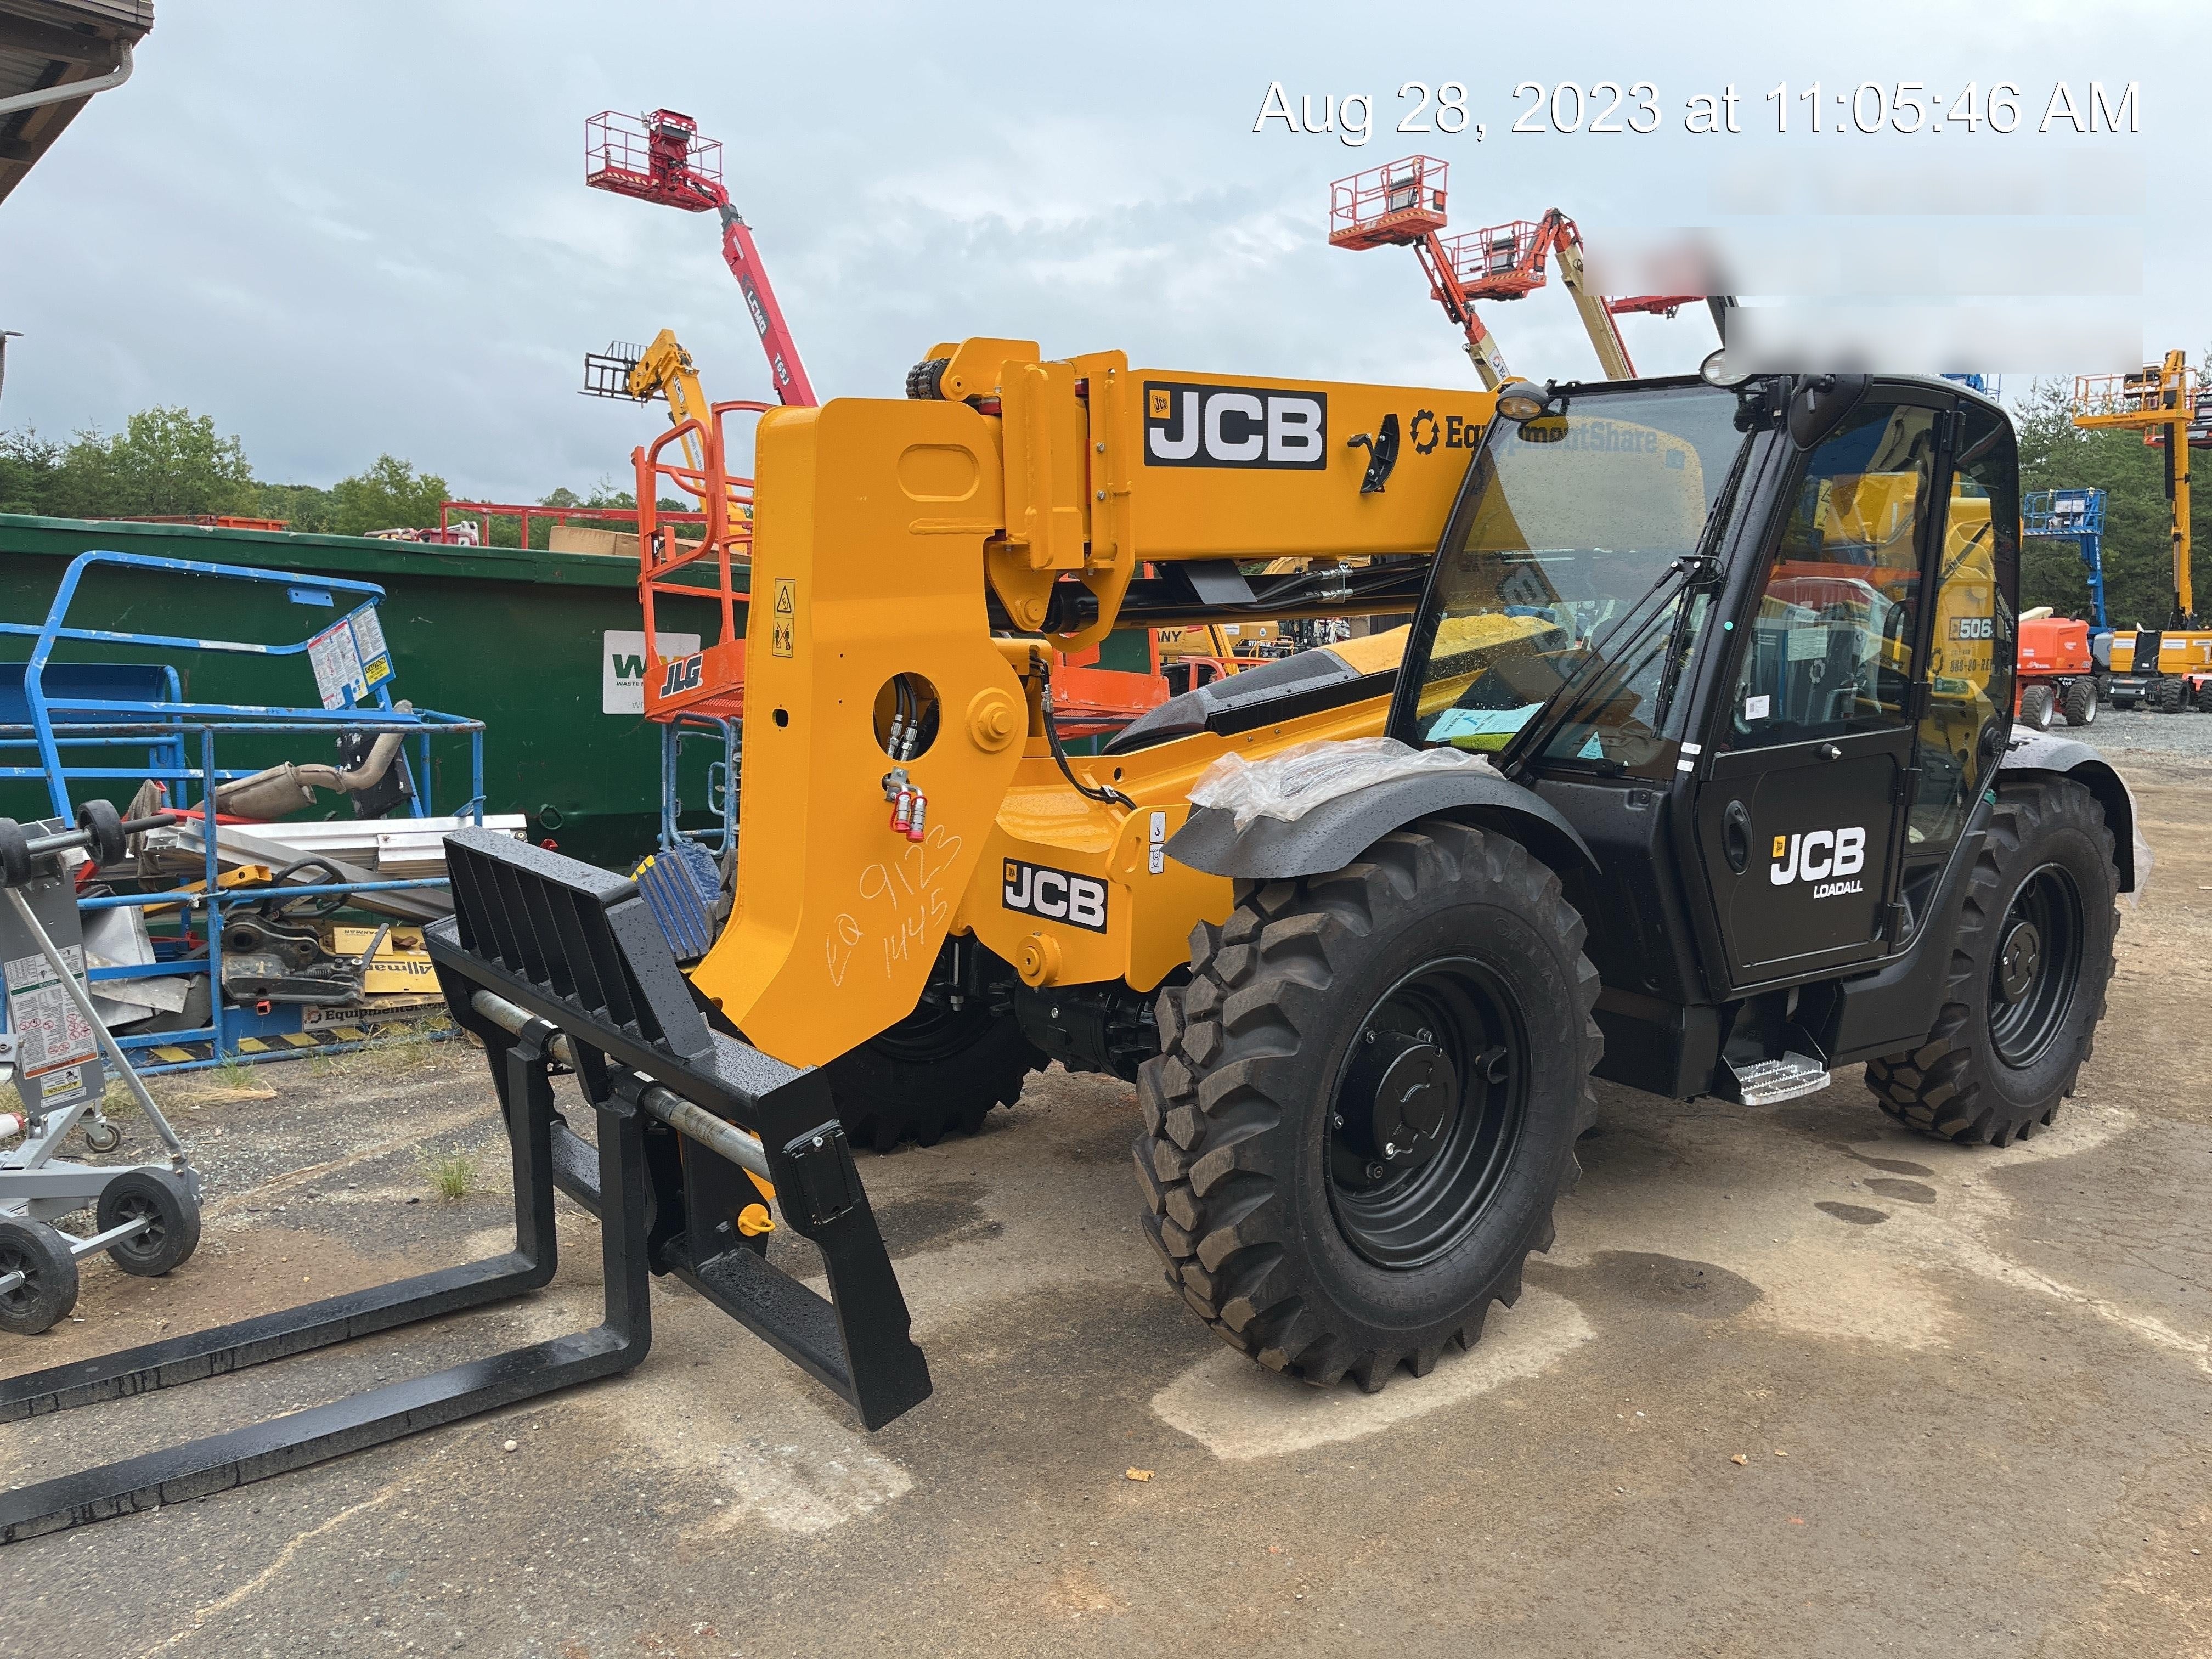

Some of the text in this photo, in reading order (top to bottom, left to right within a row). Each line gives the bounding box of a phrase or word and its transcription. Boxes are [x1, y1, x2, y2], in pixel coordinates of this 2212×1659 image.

[774, 353, 790, 386] T65J
[1155, 397, 1167, 410] JCB
[1149, 392, 1323, 462] JCB
[366, 658, 385, 673] CAUTION
[659, 653, 703, 699] JLG
[859, 824, 962, 910] 9123
[1770, 827, 1865, 885] JCB
[1005, 866, 1105, 927] JCB
[1813, 879, 1863, 899] LOADALL
[884, 888, 947, 979] 1445
[47, 1083, 71, 1096] CAUTION
